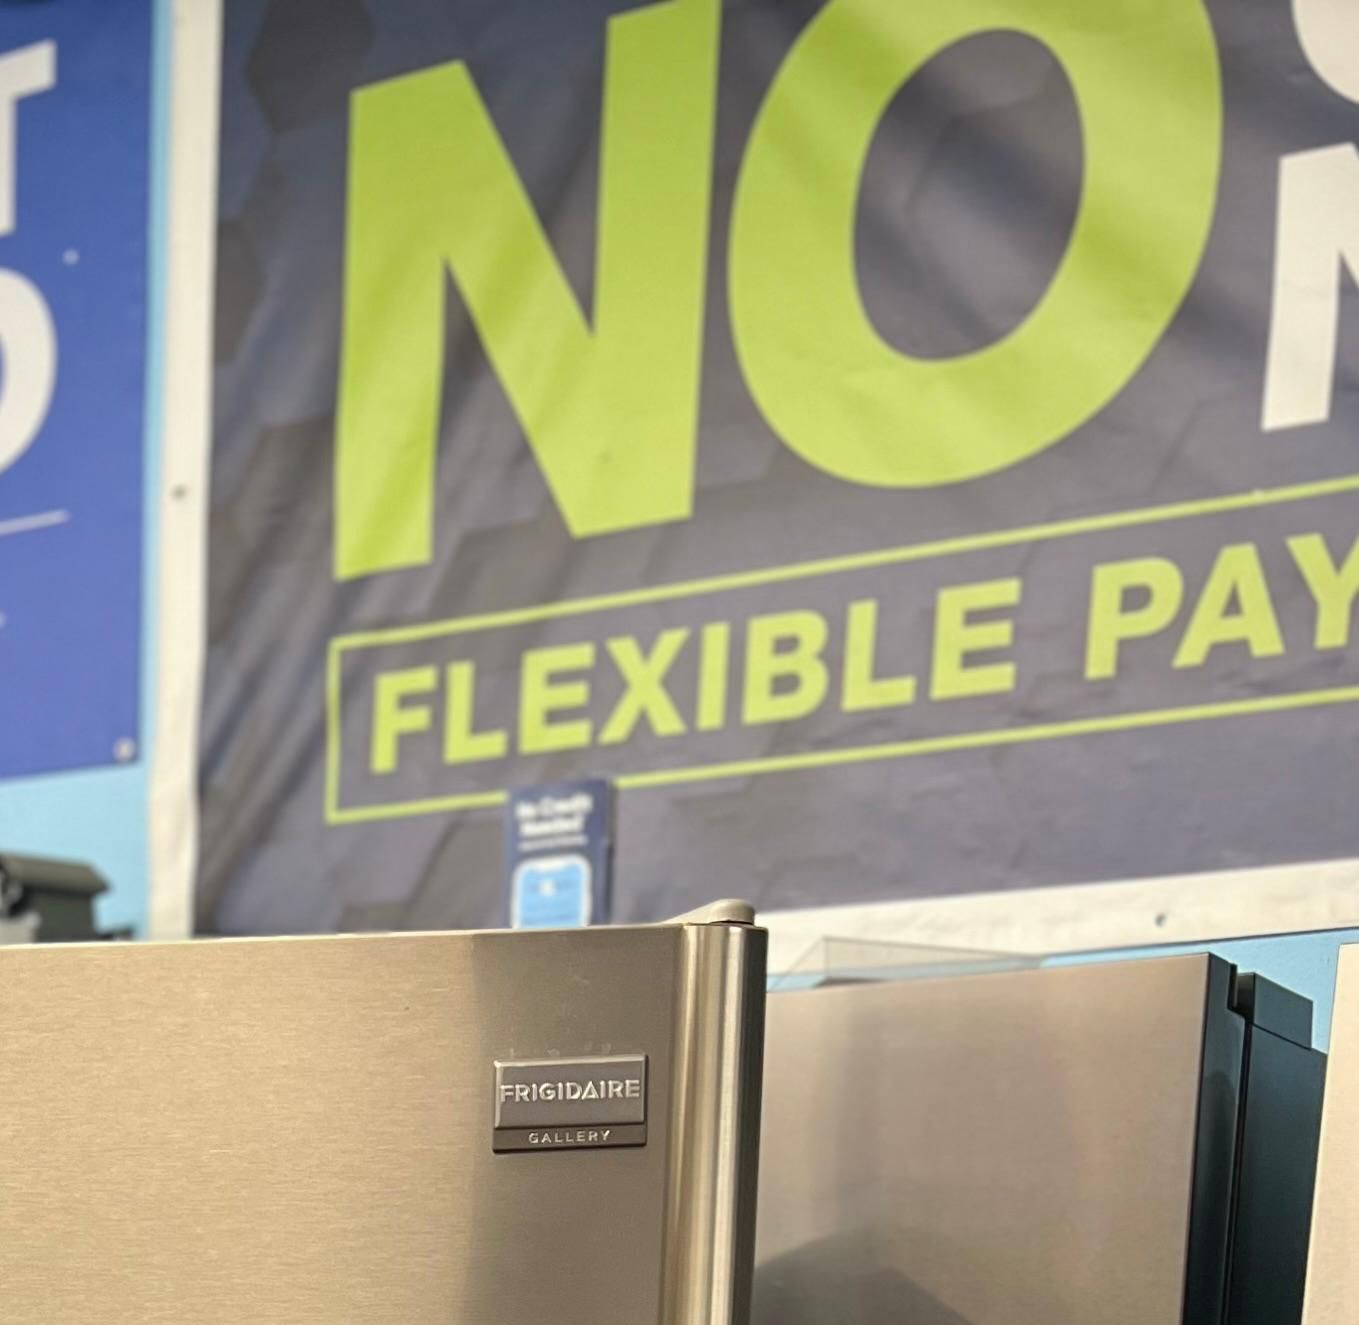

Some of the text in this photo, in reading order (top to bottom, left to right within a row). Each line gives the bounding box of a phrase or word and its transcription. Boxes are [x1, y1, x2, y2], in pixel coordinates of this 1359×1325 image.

[333, 0, 1223, 580] NO
[369, 531, 1359, 775] FLEXIBLE PAY
[500, 1079, 641, 1102] FRIGIDAIRE
[528, 1130, 611, 1144] GALLERY
